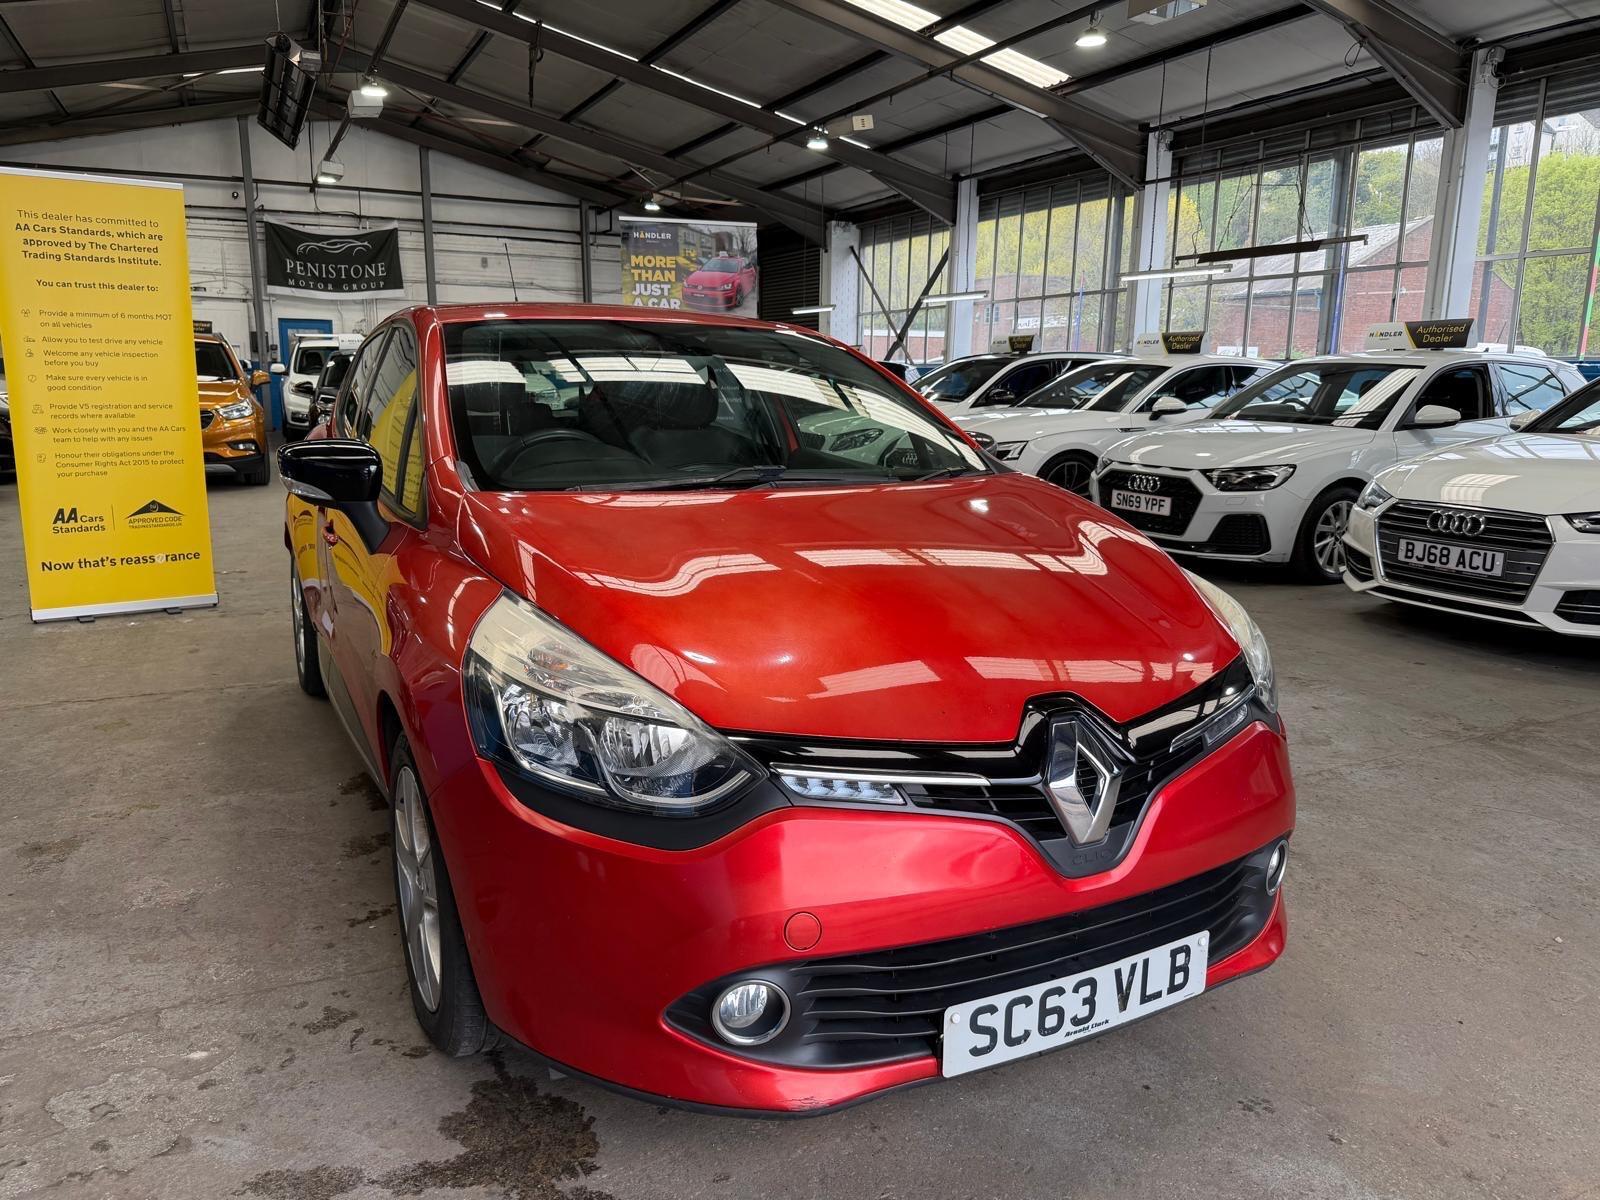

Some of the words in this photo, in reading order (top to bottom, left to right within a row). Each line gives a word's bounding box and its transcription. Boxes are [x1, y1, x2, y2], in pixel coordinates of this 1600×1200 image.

[17, 209, 39, 219] This
[41, 212, 73, 221] dealer
[76, 213, 93, 223] has
[95, 217, 147, 227] committed
[149, 219, 159, 228] to
[15, 222, 31, 231] AA
[33, 224, 57, 233] Cars
[59, 226, 115, 238] Standards,
[117, 231, 146, 239] which
[148, 233, 163, 241] are
[22, 238, 72, 248] approved
[75, 241, 87, 250] by
[88, 241, 107, 250] The
[110, 243, 159, 253] Chartered
[21, 250, 62, 262] Trading
[64, 253, 116, 263] Standards
[118, 256, 162, 266] Institute.
[630, 255, 677, 268] MORE
[285, 258, 387, 279] PENISTONE
[630, 269, 676, 282] THAN
[36, 279, 54, 287] You
[75, 281, 96, 289] trust
[288, 278, 333, 291] MOTOR
[343, 281, 385, 291] GROUP
[632, 283, 671, 296] JUST
[633, 297, 645, 307] A
[647, 298, 681, 309] CAR
[39, 309, 68, 317] Provide
[1416, 324, 1467, 333] Authorised
[1168, 334, 1200, 342] Authorised
[1422, 334, 1454, 343] Dealer
[1171, 342, 1192, 350] Dealer
[95, 460, 118, 468] Rights
[1116, 493, 1142, 508] SN69
[1144, 496, 1166, 512] YPF
[52, 507, 79, 524] AA
[80, 515, 105, 523] Cars
[128, 516, 164, 524] APPROVED
[164, 515, 183, 523] CODE
[52, 523, 106, 534] Standards
[41, 561, 74, 572] Now
[78, 556, 117, 569] that's
[120, 551, 201, 566] reassrance
[1404, 541, 1451, 566] BJ68
[1455, 549, 1496, 572] ACU
[968, 976, 1098, 1058] SC63
[1114, 944, 1192, 1014] VLB
[1064, 1024, 1090, 1038] Arnold
[1091, 1018, 1110, 1029] Clark
